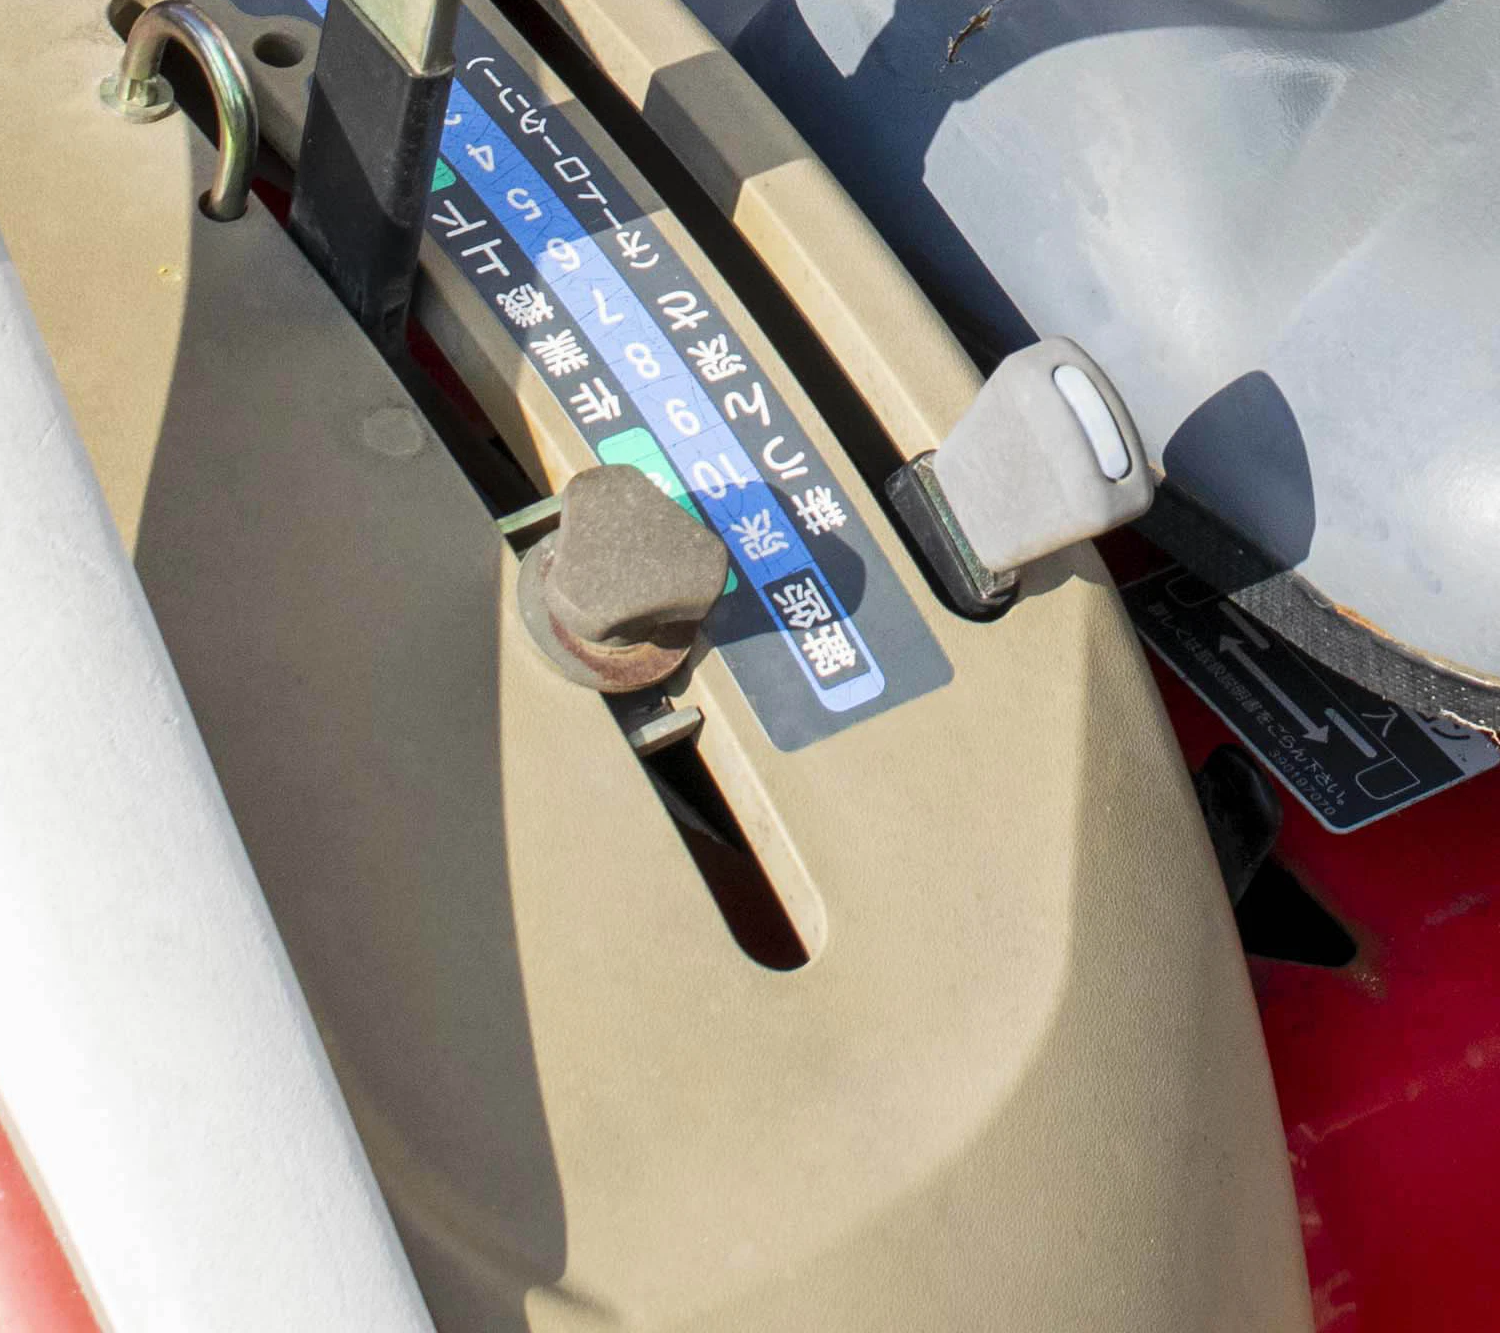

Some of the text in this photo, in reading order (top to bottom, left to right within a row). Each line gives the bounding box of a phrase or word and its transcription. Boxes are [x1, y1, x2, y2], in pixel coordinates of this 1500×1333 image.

[465, 142, 497, 173] 4
[505, 187, 543, 222] 5
[547, 236, 581, 272] 6
[431, 199, 622, 424] 作業機上下
[591, 287, 625, 327] 7
[624, 340, 661, 380] 8
[656, 288, 848, 536] 耕うん深さ
[664, 396, 701, 436] 9
[691, 452, 747, 500] 10
[730, 508, 791, 563] 深
[772, 576, 858, 677] 解除
